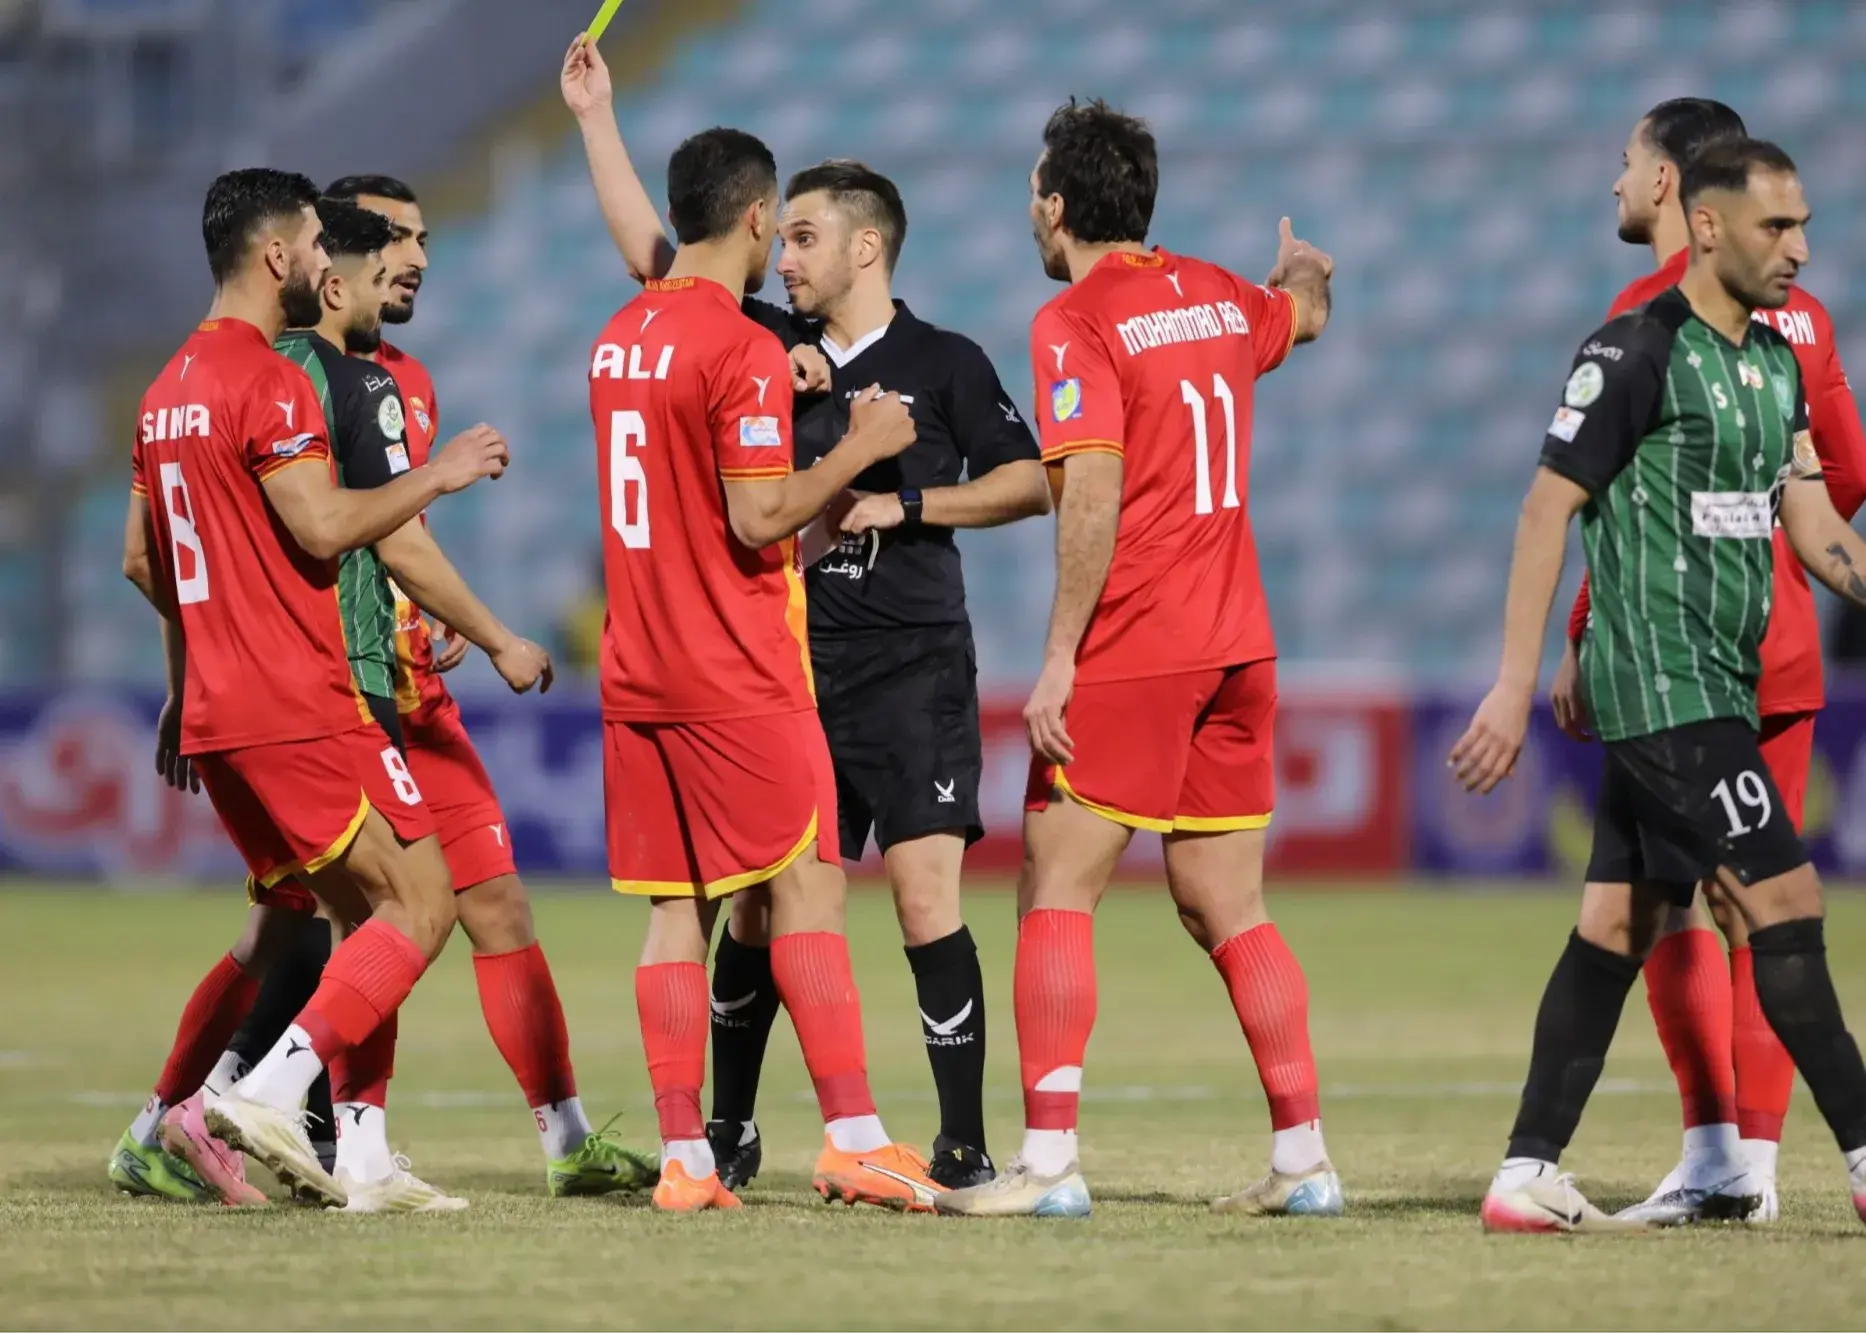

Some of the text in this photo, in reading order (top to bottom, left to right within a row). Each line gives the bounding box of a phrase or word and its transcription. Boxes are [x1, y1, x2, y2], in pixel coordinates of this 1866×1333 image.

[1116, 304, 1222, 356] MOHAMMAD
[591, 343, 675, 380] ALI
[141, 404, 210, 444] SINA
[1180, 373, 1240, 515] 11
[610, 411, 651, 549] 6
[159, 462, 210, 604] 8
[380, 746, 422, 805] 8
[1709, 769, 1772, 838] 19
[534, 1110, 548, 1133] 6
